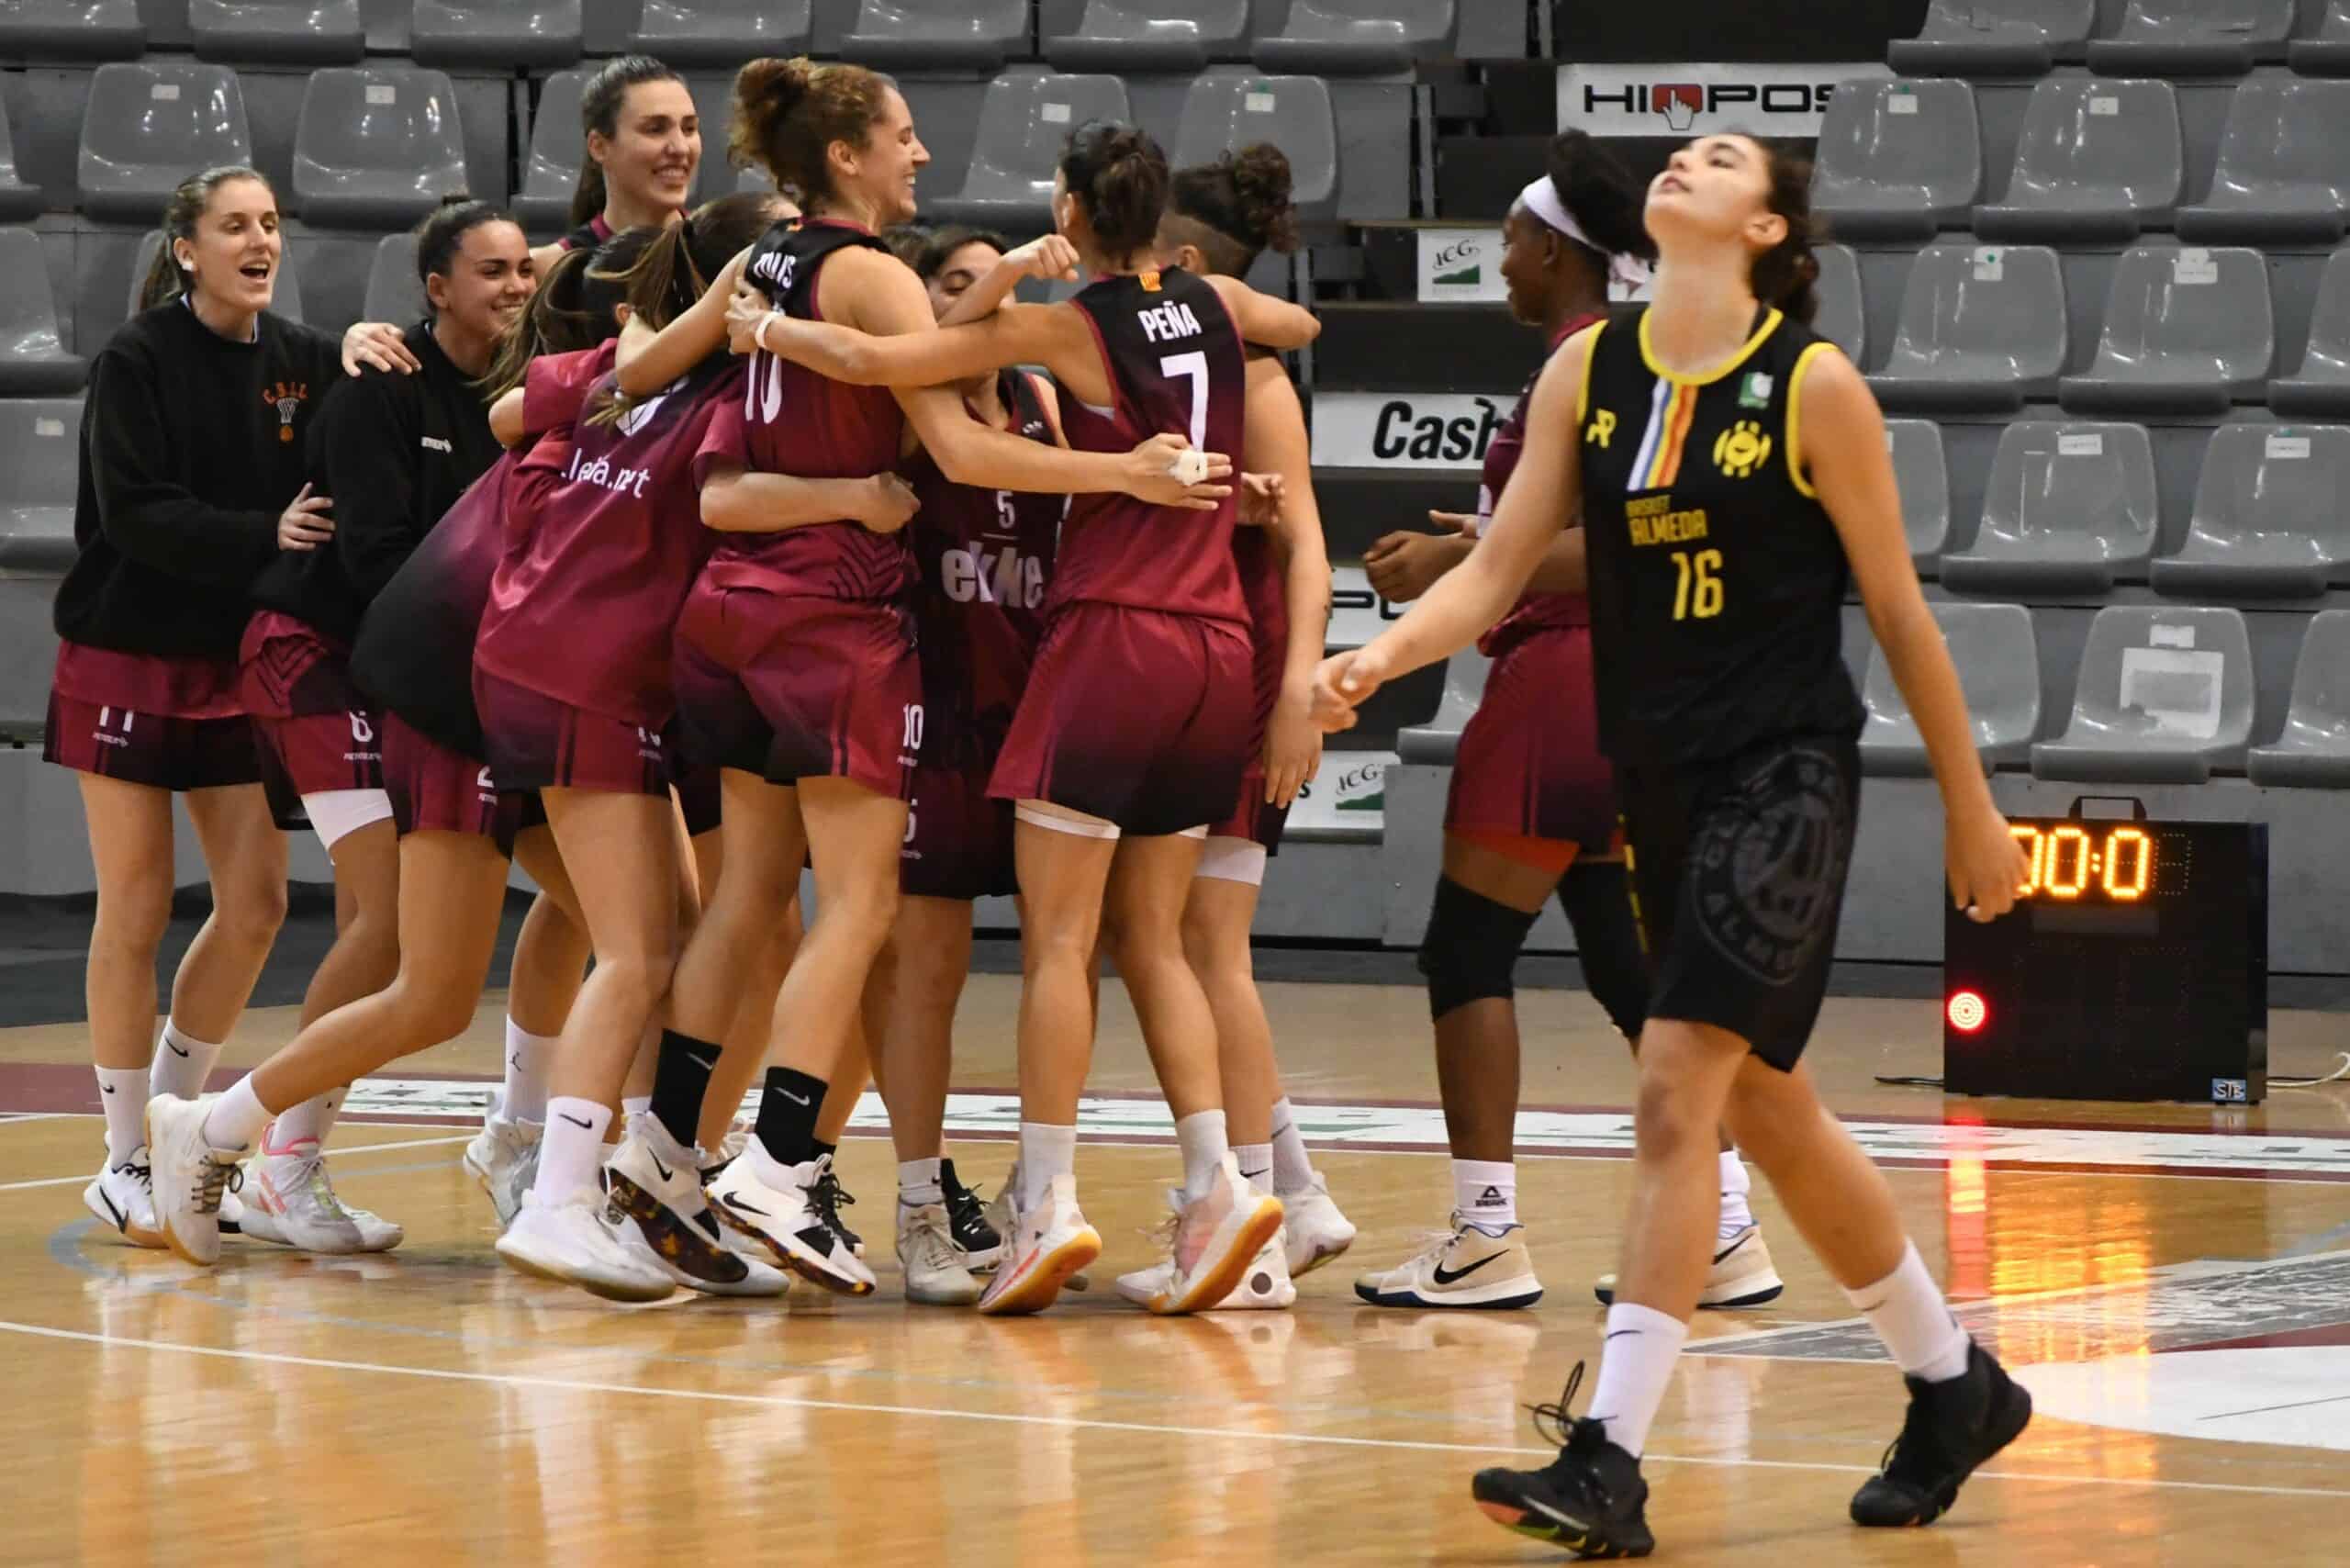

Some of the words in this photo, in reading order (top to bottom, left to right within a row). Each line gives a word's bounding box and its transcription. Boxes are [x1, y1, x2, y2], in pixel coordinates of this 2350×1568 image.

[1137, 300, 1203, 342] PEÑA
[1160, 351, 1209, 453] 7
[997, 490, 1015, 529] 5
[902, 703, 923, 750] 10
